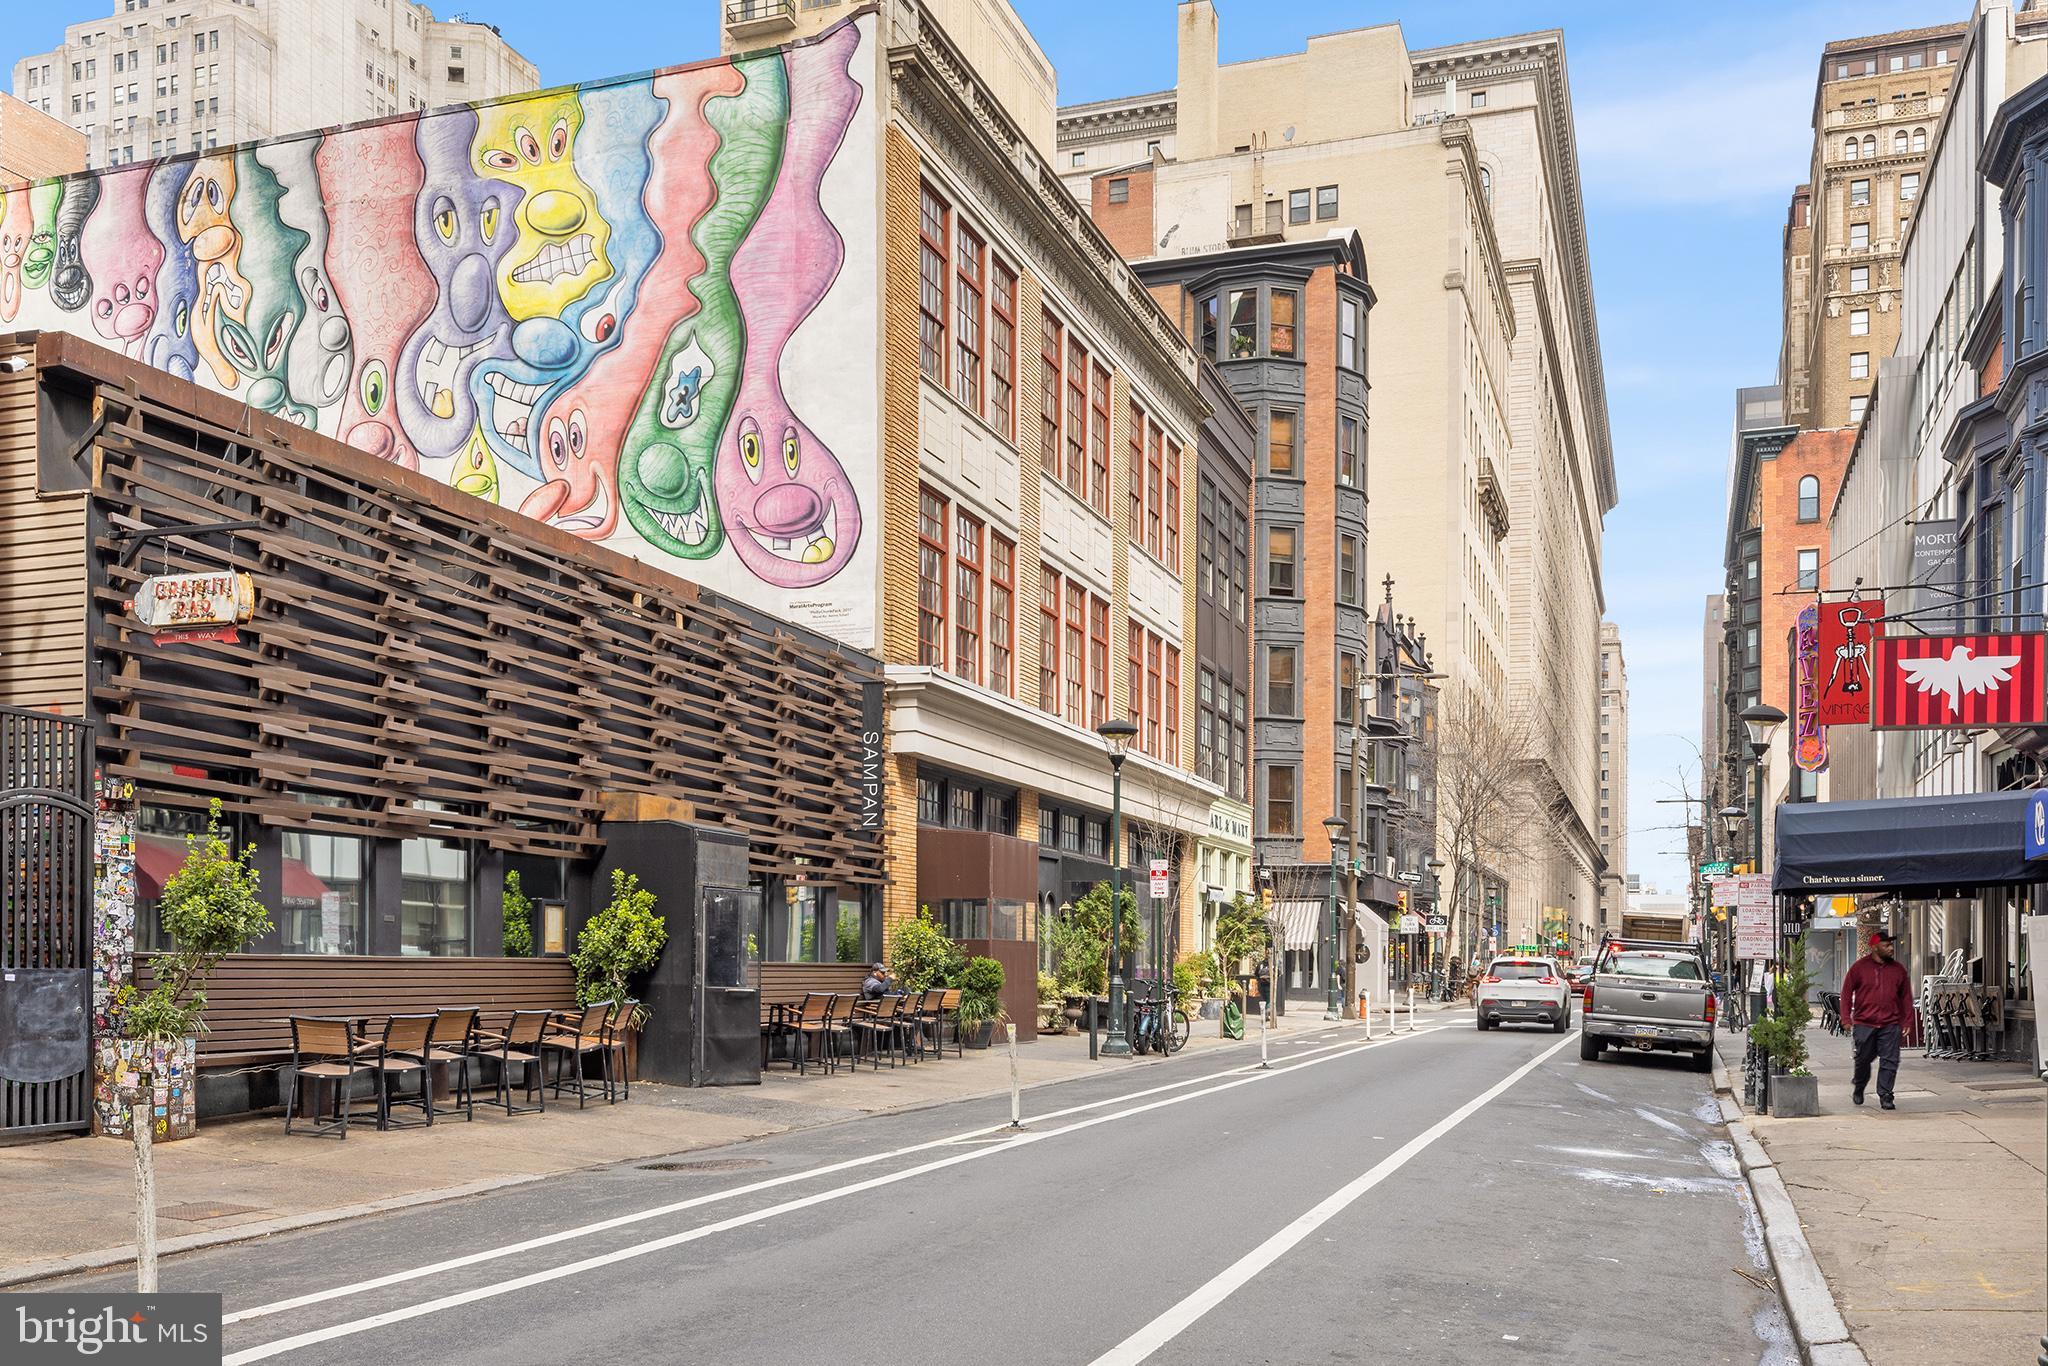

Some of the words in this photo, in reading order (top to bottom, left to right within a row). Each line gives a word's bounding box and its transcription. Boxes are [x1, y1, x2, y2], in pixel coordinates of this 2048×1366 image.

[863, 731, 879, 826] SAMPAN
[1803, 875, 1832, 884] Charlie
[1856, 874, 1885, 883] sinner.
